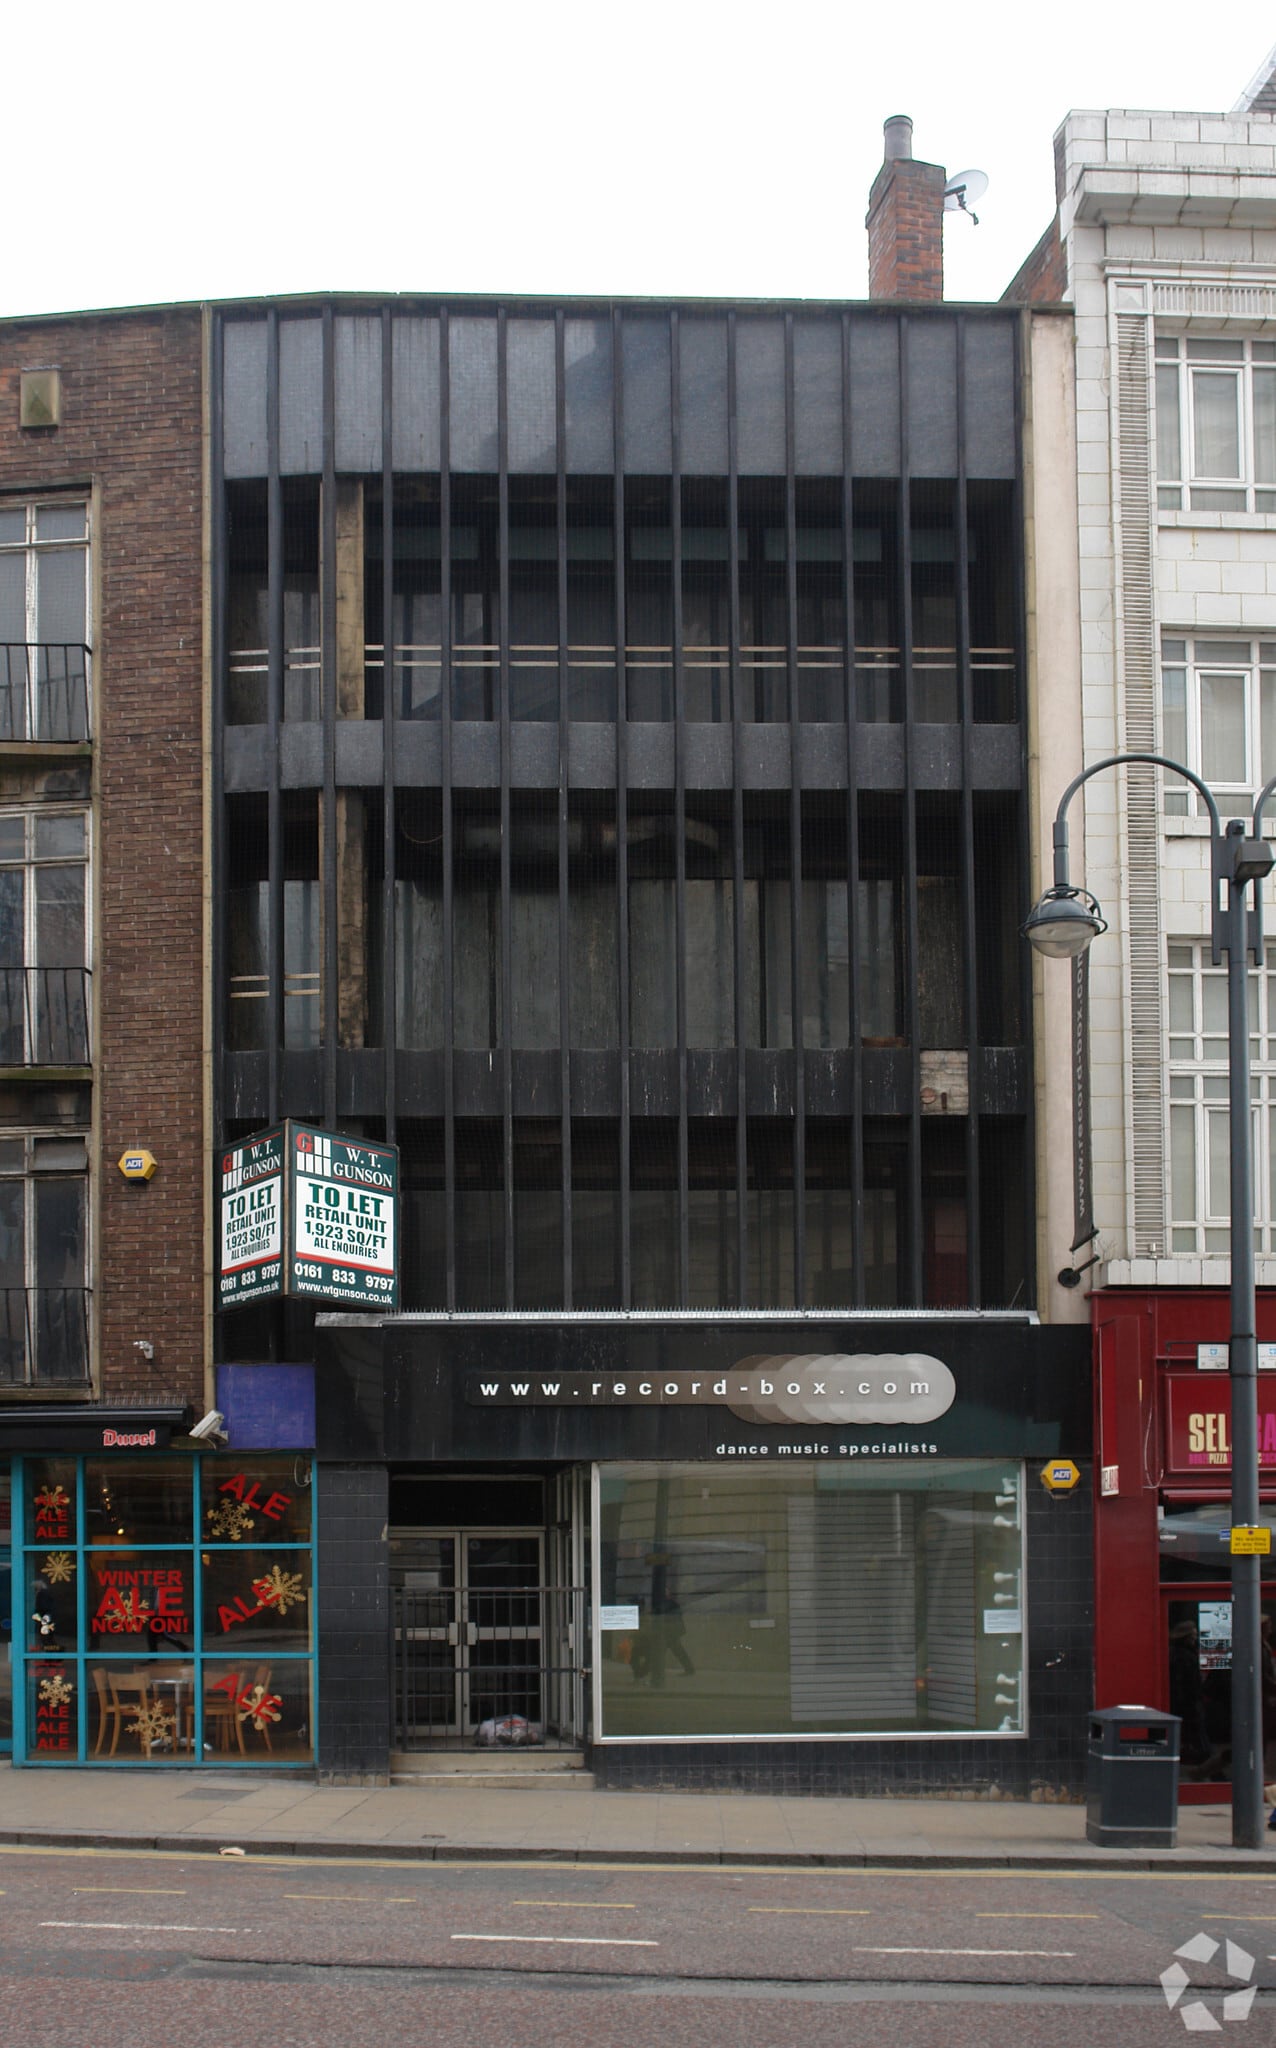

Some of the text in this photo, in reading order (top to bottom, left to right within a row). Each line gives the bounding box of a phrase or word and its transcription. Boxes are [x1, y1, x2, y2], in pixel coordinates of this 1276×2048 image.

[251, 1140, 273, 1160] W. T.
[346, 1147, 380, 1168] W. T.
[243, 1154, 280, 1180] GUNSON
[334, 1163, 392, 1188] GUNSON
[228, 1184, 274, 1219] TO LET
[309, 1184, 383, 1217] TO LET
[227, 1206, 275, 1234] RETAIL UNIT
[305, 1205, 386, 1233] RETAIL UNIT
[226, 1222, 276, 1250] 1,923 SQ/FT
[305, 1221, 387, 1248] 1,923 SQ/FT
[231, 1239, 270, 1260] ALL ENQUIRIES
[314, 1238, 378, 1258] ALL ENQUIRIES
[221, 1263, 280, 1292] 0161 833 9797
[295, 1263, 394, 1290] 0161 833 9797
[222, 1281, 279, 1304] www.wtgunson.co.uk
[298, 1281, 392, 1304] www.wtgunson.co.uk
[480, 1379, 930, 1396] www.record-box.com
[103, 1429, 156, 1446] Duvel
[1189, 1414, 1232, 1452] SEL
[716, 1442, 937, 1455] dance music specialists
[1209, 1453, 1227, 1464] PIZZA
[218, 1474, 291, 1520] ALE
[36, 1509, 68, 1522] ALE
[36, 1525, 68, 1538] ALE
[97, 1569, 182, 1586] WINTER
[96, 1586, 184, 1616] ALE
[216, 1577, 281, 1632] ALE
[92, 1617, 188, 1633] NOW ON!
[213, 1673, 284, 1724] ALE
[37, 1706, 69, 1718] ALE
[37, 1722, 69, 1734] ALE
[37, 1738, 69, 1750] ALE
